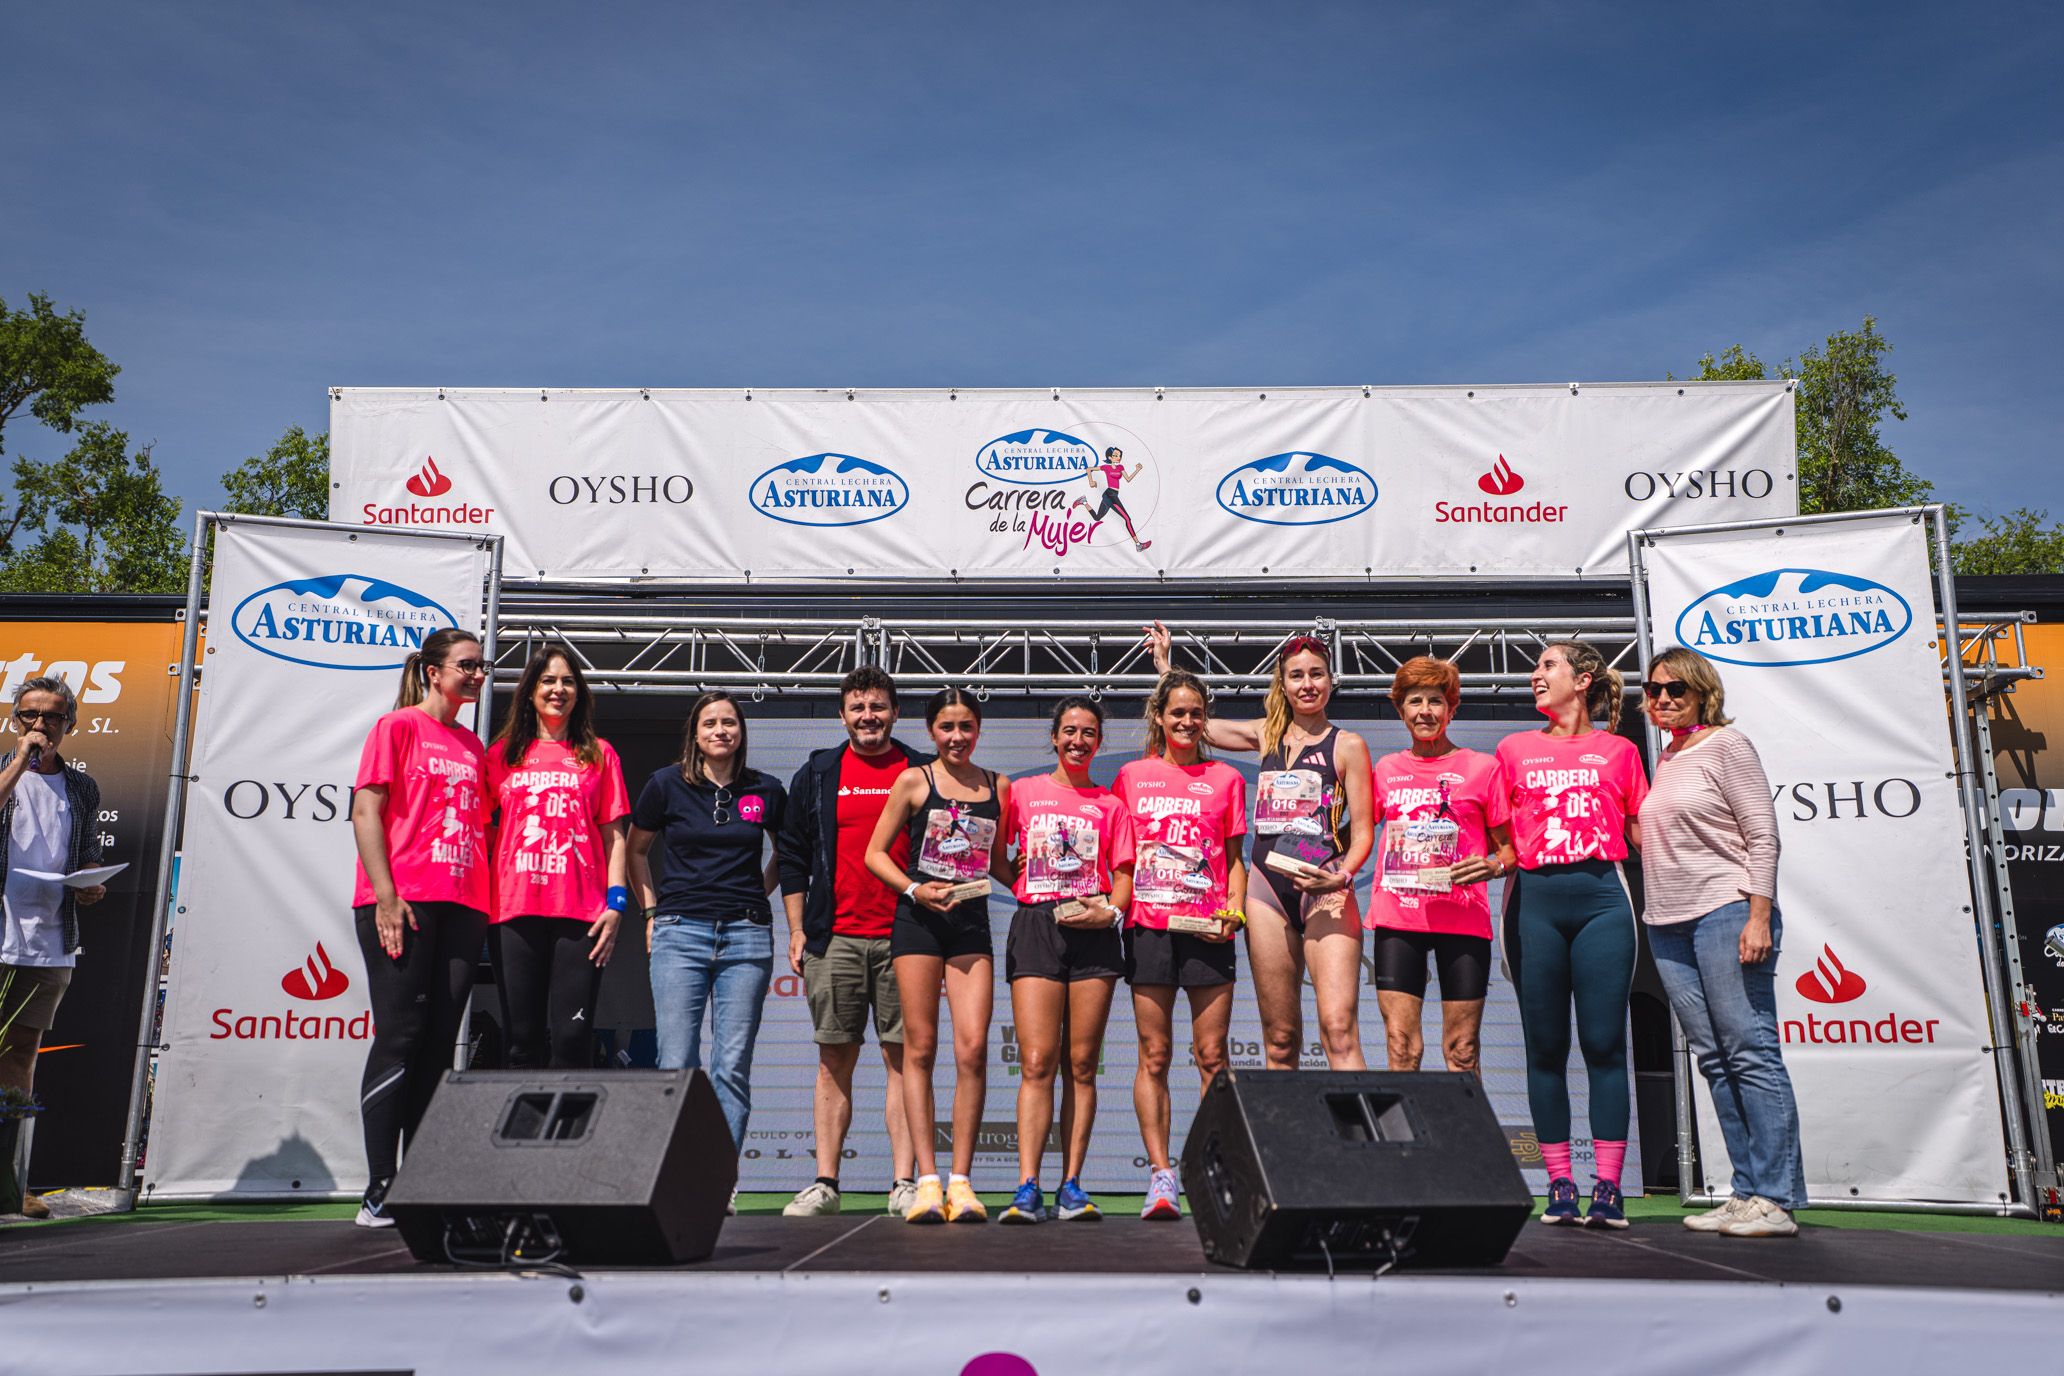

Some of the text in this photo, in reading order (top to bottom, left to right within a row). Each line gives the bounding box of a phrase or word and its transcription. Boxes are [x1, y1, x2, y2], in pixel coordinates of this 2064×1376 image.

[985, 449, 1088, 471] ASTURIANA
[549, 474, 694, 505] OYSHO
[786, 478, 892, 486] CENTRAL LECHERA
[1253, 476, 1361, 485] CENTRAL LECHERA
[1624, 469, 1773, 501] OYSHO
[761, 480, 898, 508] ASTURIANA
[965, 481, 1066, 511] Carrera
[1229, 480, 1367, 507] ASTURIANA
[363, 503, 494, 525] Santander
[1435, 501, 1568, 523] Santander
[989, 508, 1104, 556] de la Mujer
[287, 602, 437, 623] CENTRAL LECHERA
[1726, 595, 1884, 615] CENTRAL LECHERA
[248, 602, 438, 648] ASTURIAN
[1694, 608, 1895, 646] ASTURIANA
[88, 717, 120, 734] SL.
[511, 771, 580, 789] CARRERA
[1136, 781, 1166, 789] OYSHO
[1526, 768, 1600, 789] CARRERA
[546, 791, 567, 818] DE
[1137, 796, 1201, 815] CARRERA
[1567, 791, 1591, 818] DE
[1167, 818, 1190, 845] DE
[515, 851, 568, 874] MUJER
[1777, 1012, 1940, 1043] ntander
